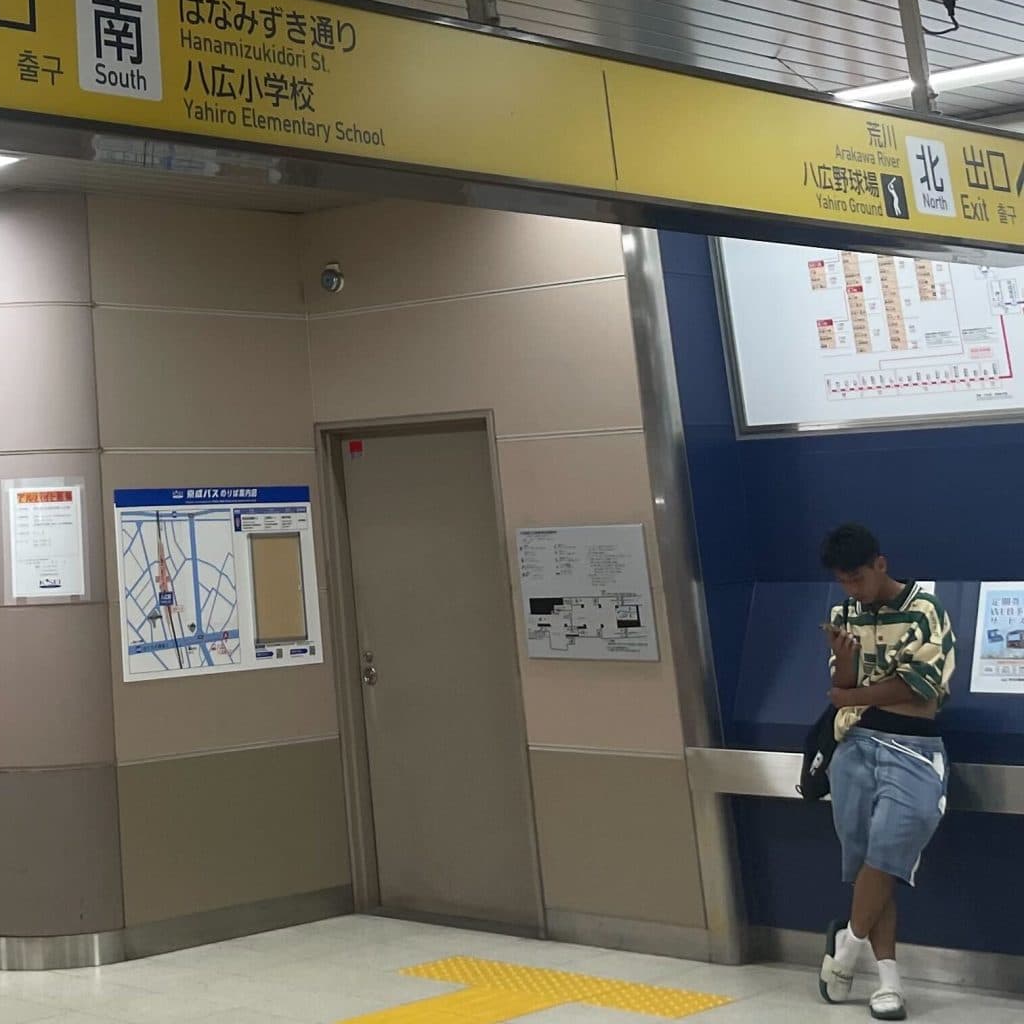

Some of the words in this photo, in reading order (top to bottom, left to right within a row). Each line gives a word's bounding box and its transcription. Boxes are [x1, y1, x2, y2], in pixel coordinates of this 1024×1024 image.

[17, 49, 64, 86] 출구
[180, 28, 307, 69] Hanamizukidōri
[311, 52, 331, 73] St.
[95, 63, 147, 91] South
[183, 60, 315, 112] 八広小学校
[183, 98, 237, 125] Yahiro
[242, 107, 331, 143] Elementary
[335, 122, 385, 146] School
[866, 121, 897, 150] 荒川
[835, 144, 876, 165] Arakawa
[877, 151, 901, 169] River
[916, 144, 944, 192] 北
[962, 144, 1011, 193] 出口
[803, 161, 880, 198] 八広野球場
[816, 193, 848, 212] Yahiro
[848, 197, 884, 217] Ground
[922, 193, 949, 211] North
[960, 193, 990, 223] Exit
